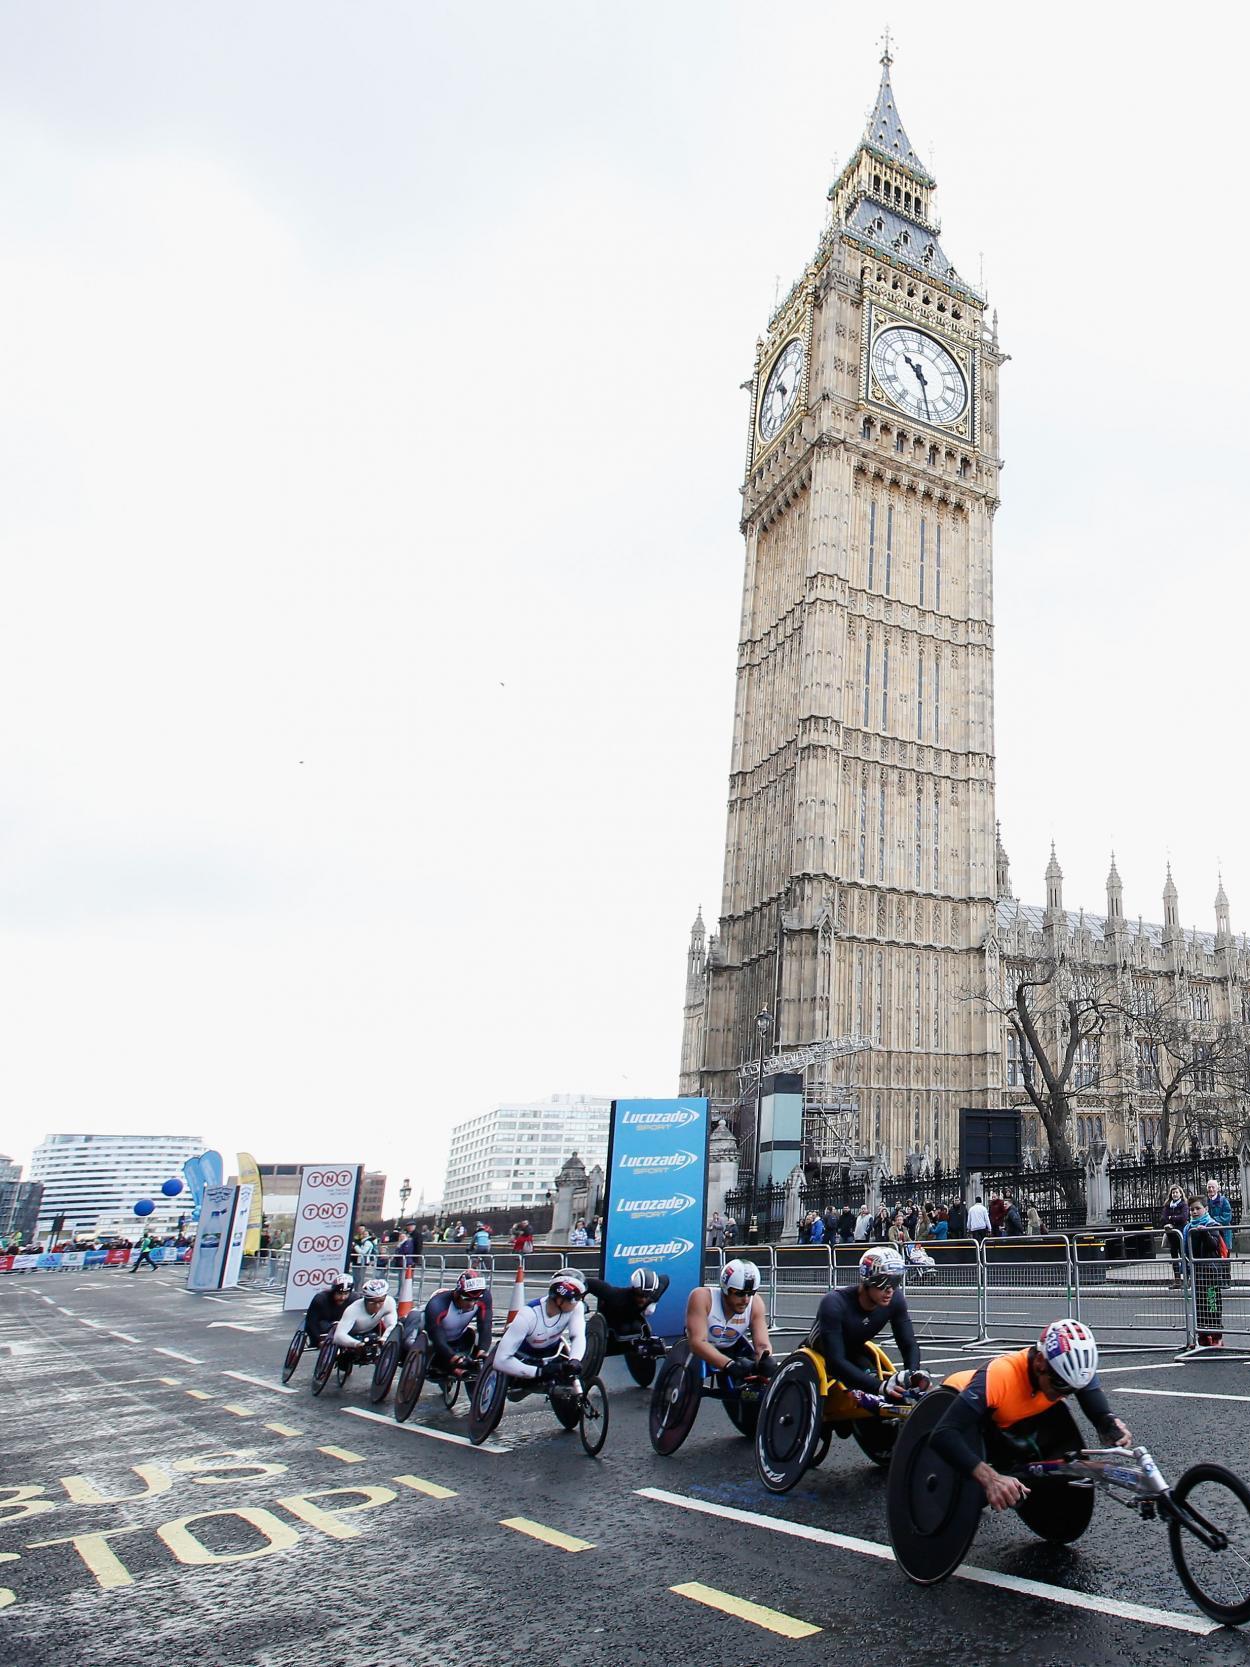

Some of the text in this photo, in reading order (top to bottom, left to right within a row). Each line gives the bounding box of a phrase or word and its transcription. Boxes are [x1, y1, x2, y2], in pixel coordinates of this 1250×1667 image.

[622, 1110, 688, 1124] Lucozade
[619, 1153, 686, 1168] Lucozade
[632, 1167, 670, 1175] SPORT
[310, 1172, 350, 1185] TNT
[616, 1196, 684, 1212] Lucozade
[305, 1205, 346, 1218] TNT
[630, 1211, 668, 1219] SPORT
[301, 1237, 341, 1250] TNT
[613, 1241, 682, 1258] Lucozade
[628, 1255, 666, 1264] SPORT
[296, 1270, 337, 1284] TNT
[1046, 1333, 1058, 1352] 28
[0, 1486, 397, 1604] TOP
